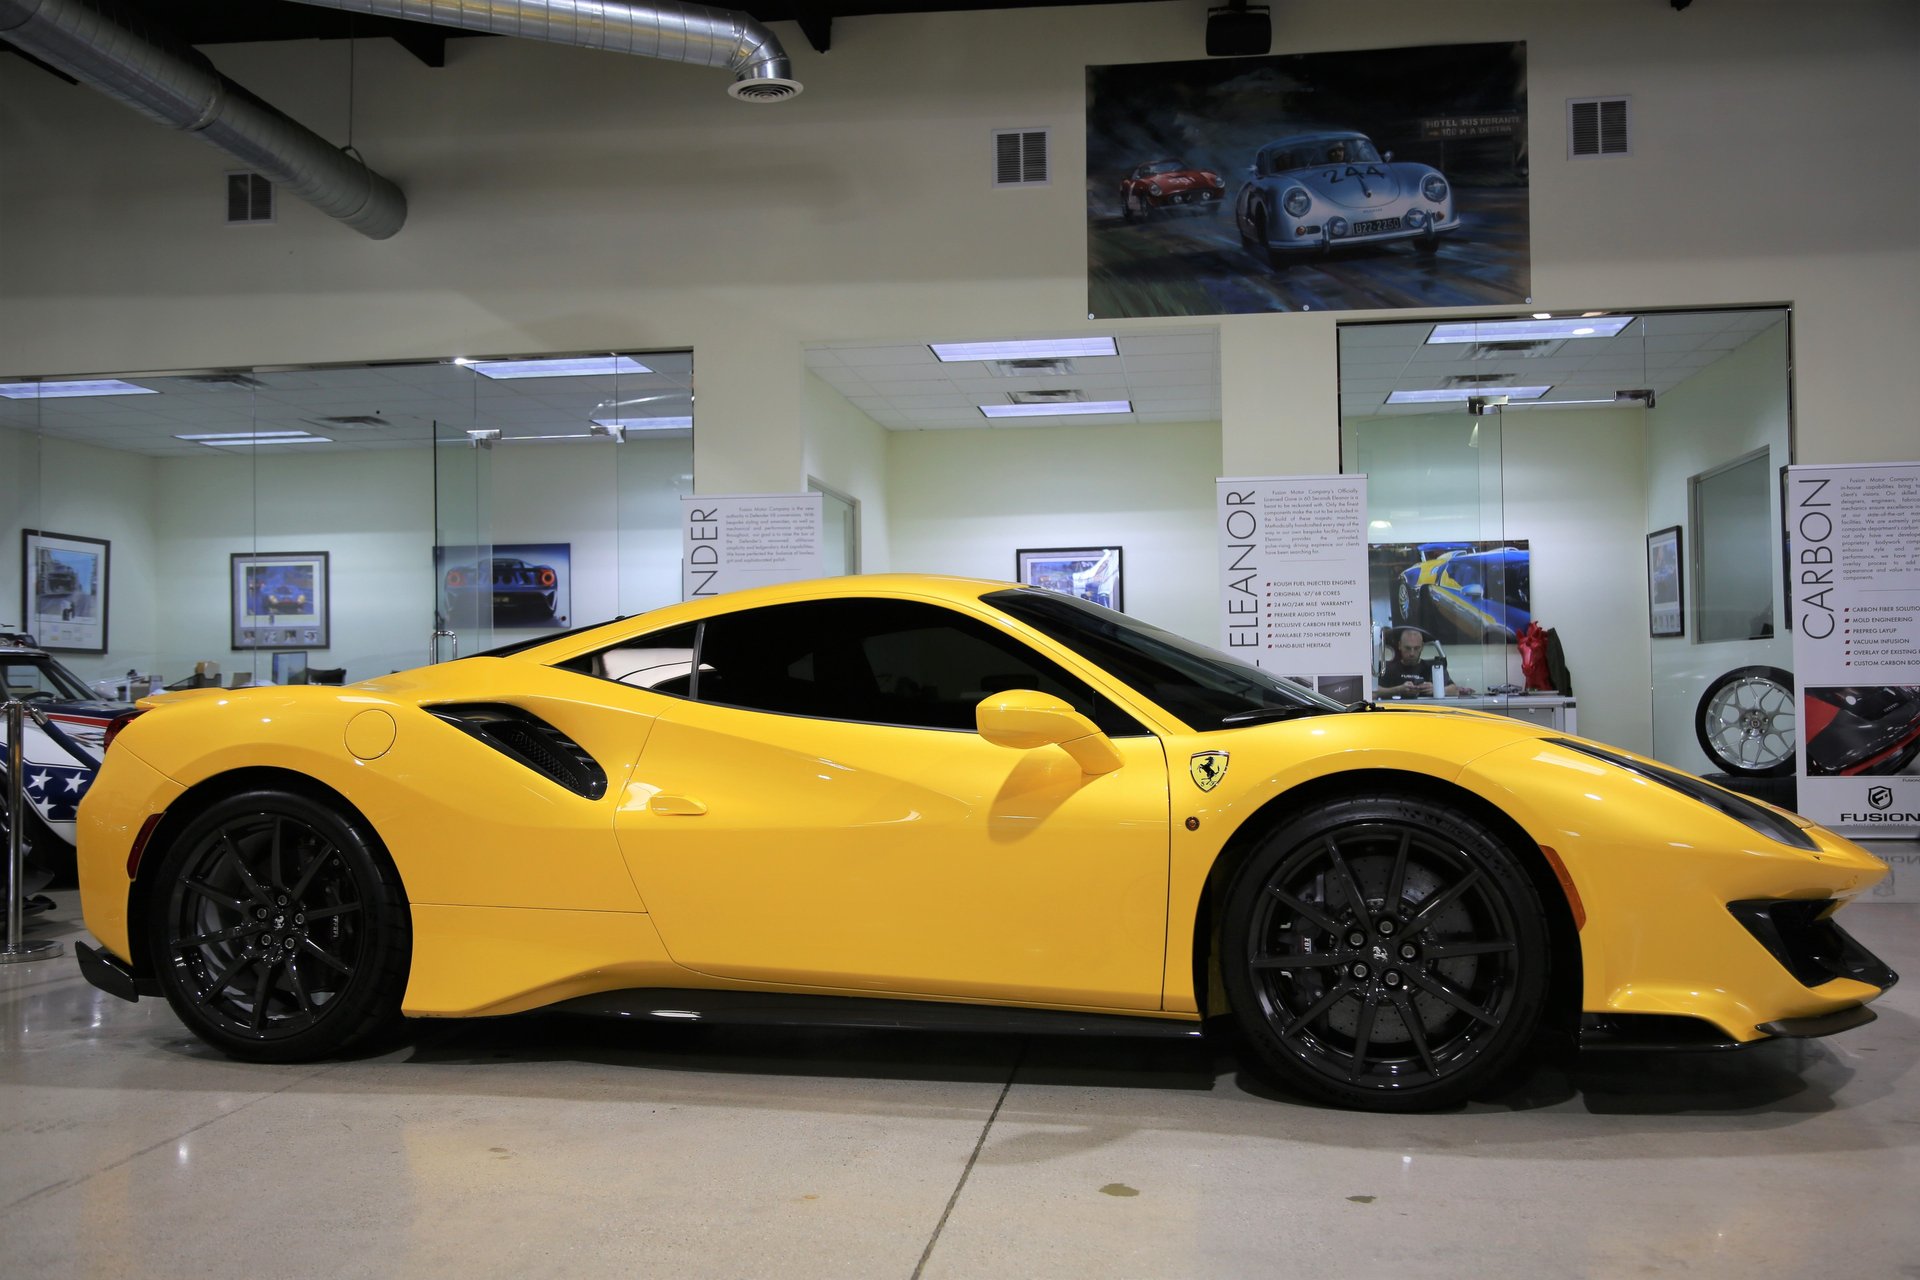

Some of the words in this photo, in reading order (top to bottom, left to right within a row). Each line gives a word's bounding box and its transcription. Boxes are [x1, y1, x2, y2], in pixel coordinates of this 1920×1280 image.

[1323, 166, 1385, 184] 244
[1226, 490, 1258, 647] ELEANOR
[1798, 479, 1835, 639] CARBON
[1841, 813, 1920, 822] FUSION
